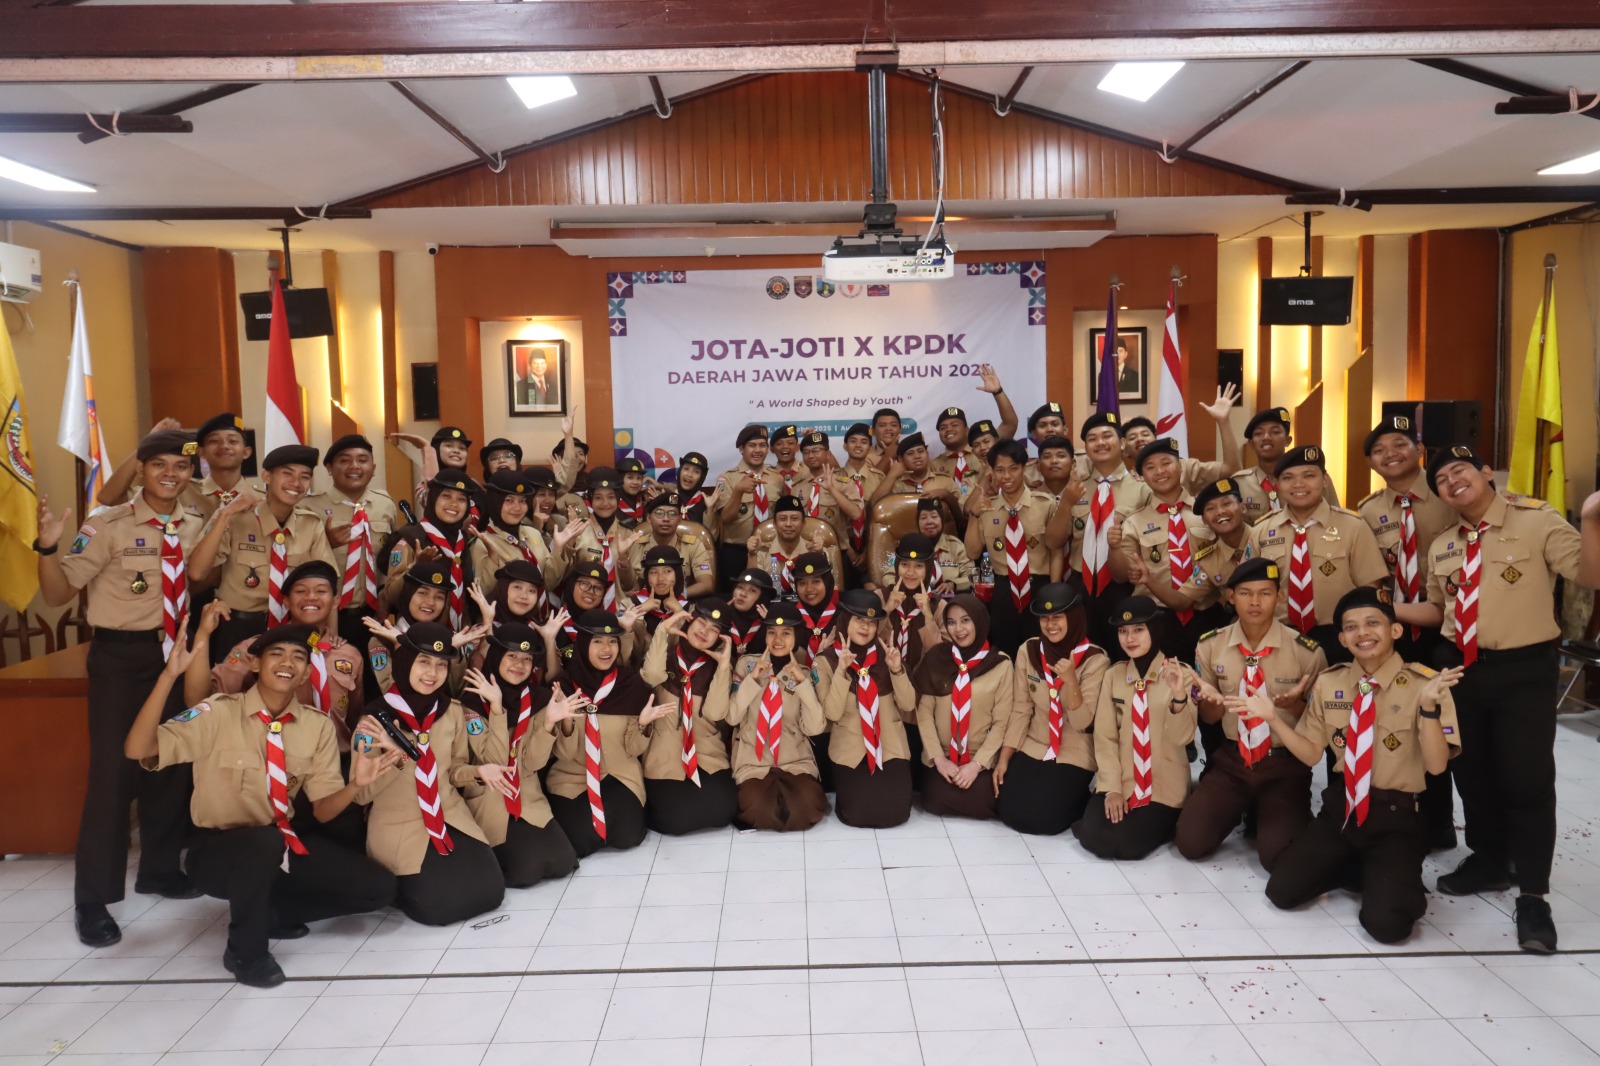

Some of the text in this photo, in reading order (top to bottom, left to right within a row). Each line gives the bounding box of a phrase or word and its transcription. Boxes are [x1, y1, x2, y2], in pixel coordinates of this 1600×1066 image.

[690, 333, 967, 361] JOTA-JOTI X KPDK
[668, 363, 991, 384] DAERAH JAWA TIMUR TAHUN 202
[769, 398, 803, 408] World
[806, 398, 849, 409] Shaped
[853, 397, 867, 408] by
[870, 395, 904, 406] Youth
